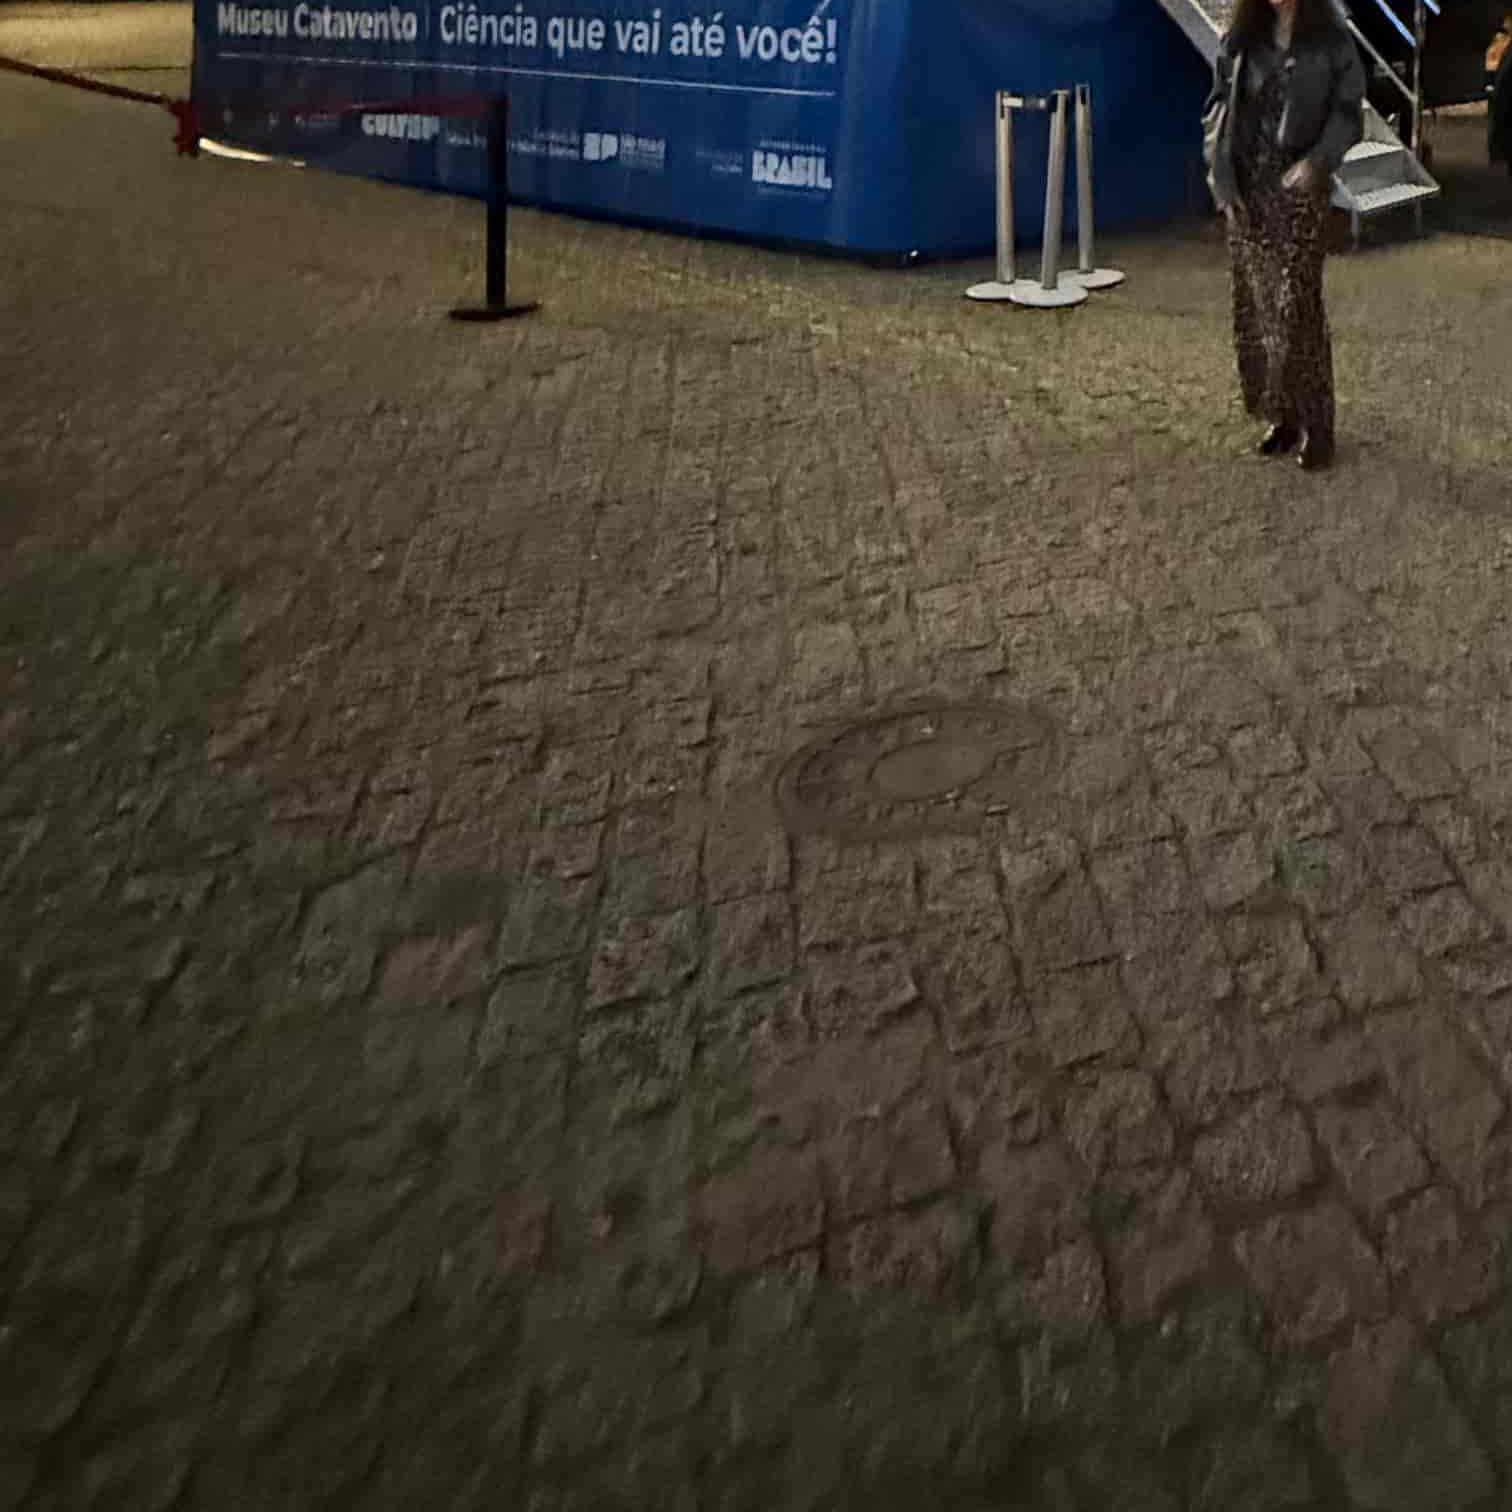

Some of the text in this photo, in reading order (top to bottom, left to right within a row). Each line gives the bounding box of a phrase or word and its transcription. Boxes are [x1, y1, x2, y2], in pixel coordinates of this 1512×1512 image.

[217, 1, 837, 64] Museu Catavento Ciência que vai até você!
